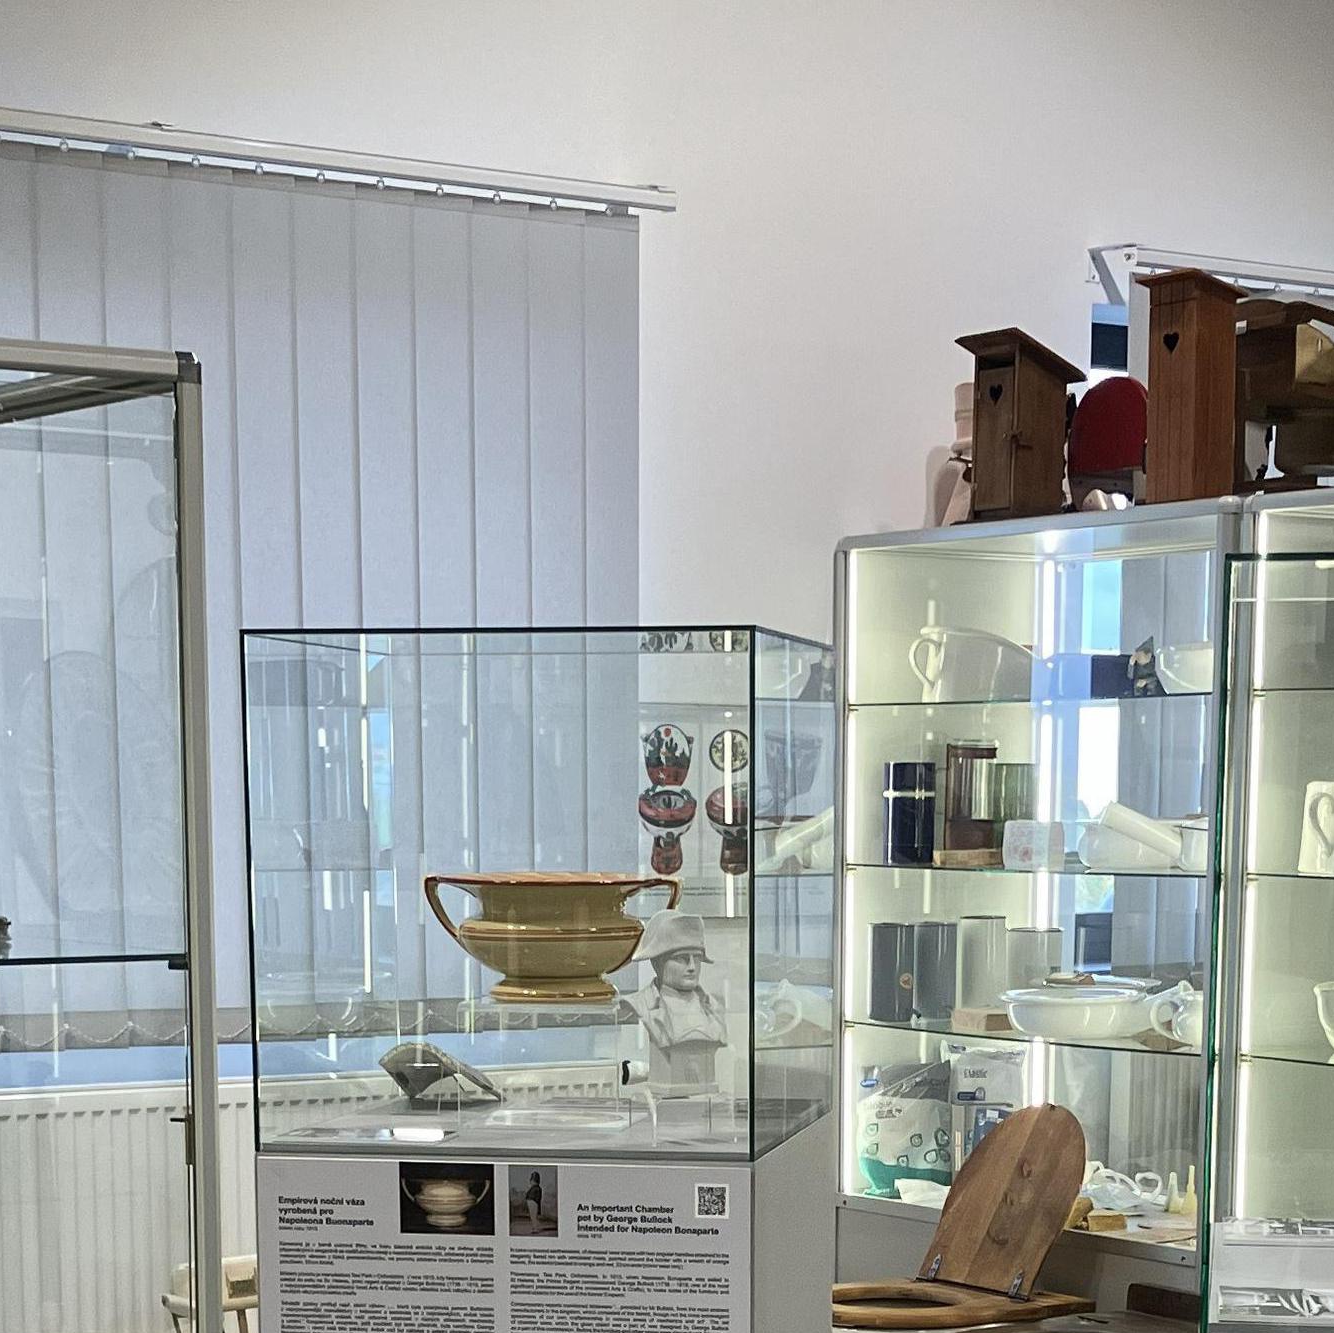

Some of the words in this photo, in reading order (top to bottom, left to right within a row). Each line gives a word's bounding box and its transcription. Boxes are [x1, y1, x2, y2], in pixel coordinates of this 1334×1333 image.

[346, 1197, 365, 1206] váza
[320, 1208, 334, 1216] pro
[577, 1204, 589, 1212] An
[635, 1205, 674, 1214] Chamber
[577, 1214, 591, 1222] pot
[593, 1215, 604, 1223] by
[606, 1215, 638, 1225] George
[617, 1225, 629, 1233] for
[631, 1226, 672, 1236] Napoleon
